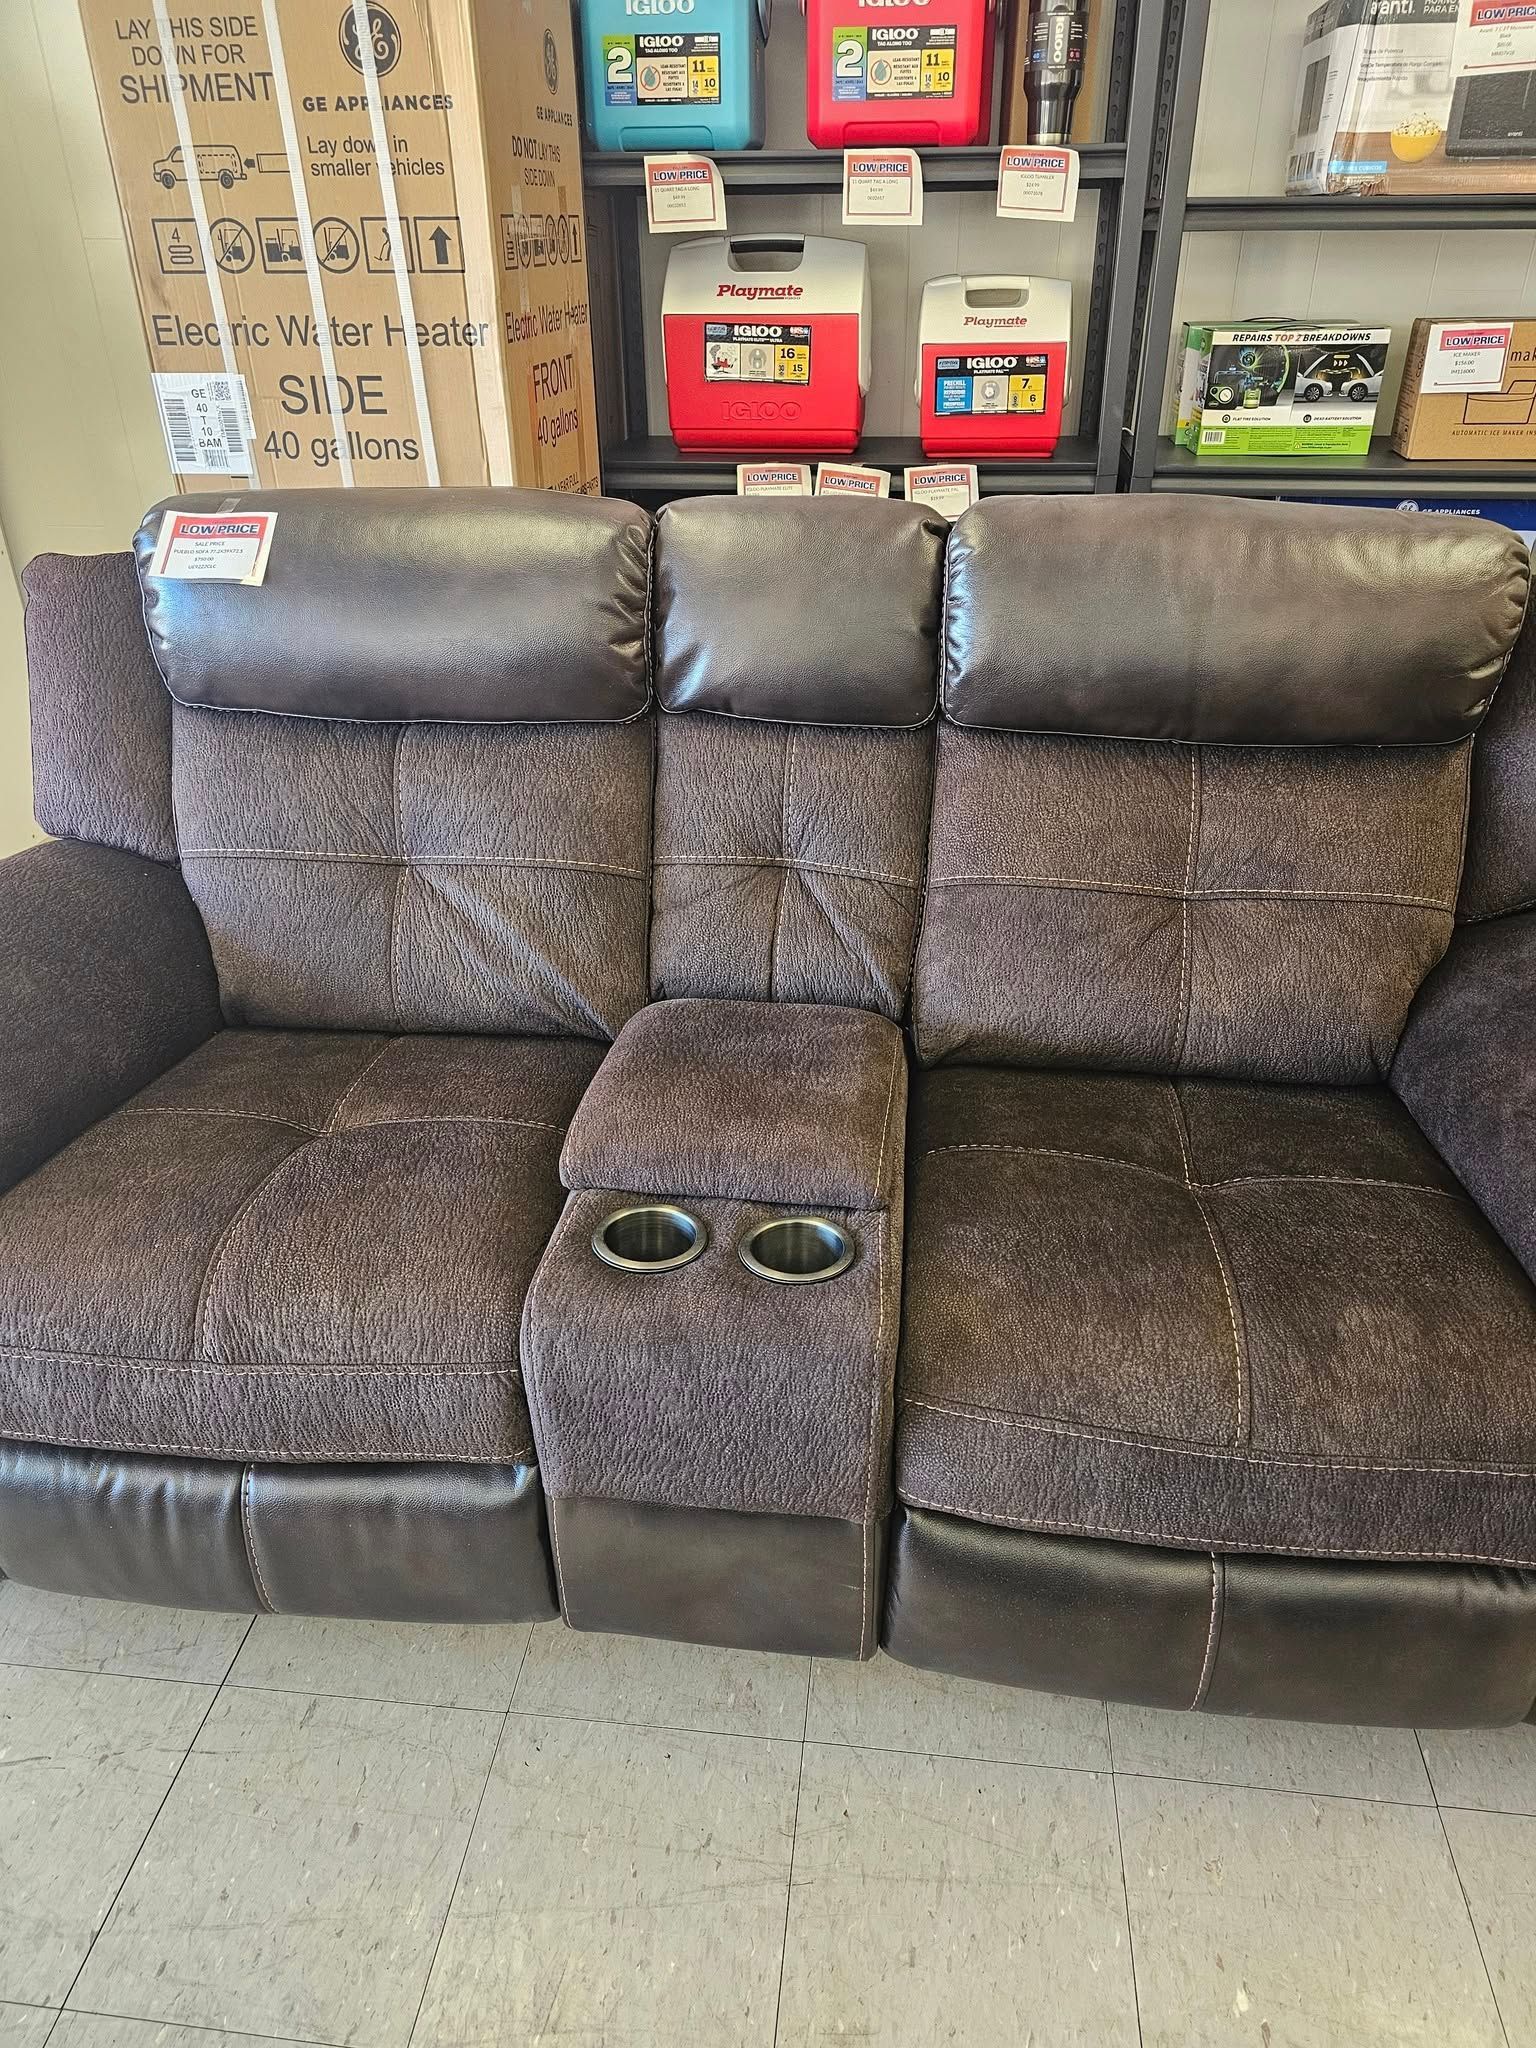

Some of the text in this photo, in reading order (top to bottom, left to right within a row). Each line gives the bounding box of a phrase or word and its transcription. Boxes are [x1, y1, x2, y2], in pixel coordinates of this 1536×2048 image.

[1423, 6, 1447, 14] PARA
[1477, 9, 1505, 20] LOW
[115, 16, 259, 40] LAY HIS SIDE
[871, 28, 919, 41] IGLOO
[1053, 16, 1065, 63] IGLOO
[639, 36, 684, 48] IGLOO
[201, 44, 246, 64] FOR
[836, 39, 864, 78] 2
[926, 53, 940, 66] 11
[607, 46, 633, 84] 2
[692, 60, 706, 73] 11
[937, 72, 950, 81] 10
[120, 71, 274, 104] SHIPMENT
[704, 78, 716, 88] 10
[303, 95, 454, 112] GE APPIANCES
[536, 105, 573, 127] GE APPLIANCES
[306, 135, 408, 158] Lay dow in
[511, 135, 523, 157] DO
[523, 137, 537, 159] NOT
[310, 158, 371, 176] smaller
[853, 163, 908, 172] LOW PRICE
[1007, 157, 1065, 168] LOW PRICE
[653, 170, 708, 181] LOW PRICE
[716, 284, 804, 300] Playmate
[505, 300, 588, 344] Electric Water Heater
[963, 316, 1028, 329] Playmate
[152, 314, 270, 347] Elecric
[383, 314, 489, 347] Heater
[733, 325, 783, 337] IGLOO
[1232, 334, 1273, 342] REPAIRS
[1275, 334, 1294, 342] TOP
[1302, 333, 1372, 341] BREAKDOWNS
[1446, 336, 1504, 346] LOW PRICE
[780, 348, 795, 359] 16
[792, 364, 803, 372] 15
[966, 357, 1017, 369] IGLOO
[532, 353, 574, 403] FRONT
[1022, 378, 1030, 389] 7
[191, 389, 207, 399] GE
[279, 374, 388, 415] SIDE
[1029, 394, 1036, 402] 6
[196, 403, 208, 413] 40
[720, 401, 802, 420] IGLOO
[200, 416, 206, 425] T
[201, 427, 213, 437] 10
[537, 408, 579, 448] 40 gallons
[199, 438, 222, 448] BAM
[264, 430, 300, 460] 40
[747, 473, 797, 482] LOW PRICE
[824, 476, 875, 490] LOW PRICE
[914, 474, 966, 485] LOW PRICE
[181, 524, 259, 534] LOW PRICE
